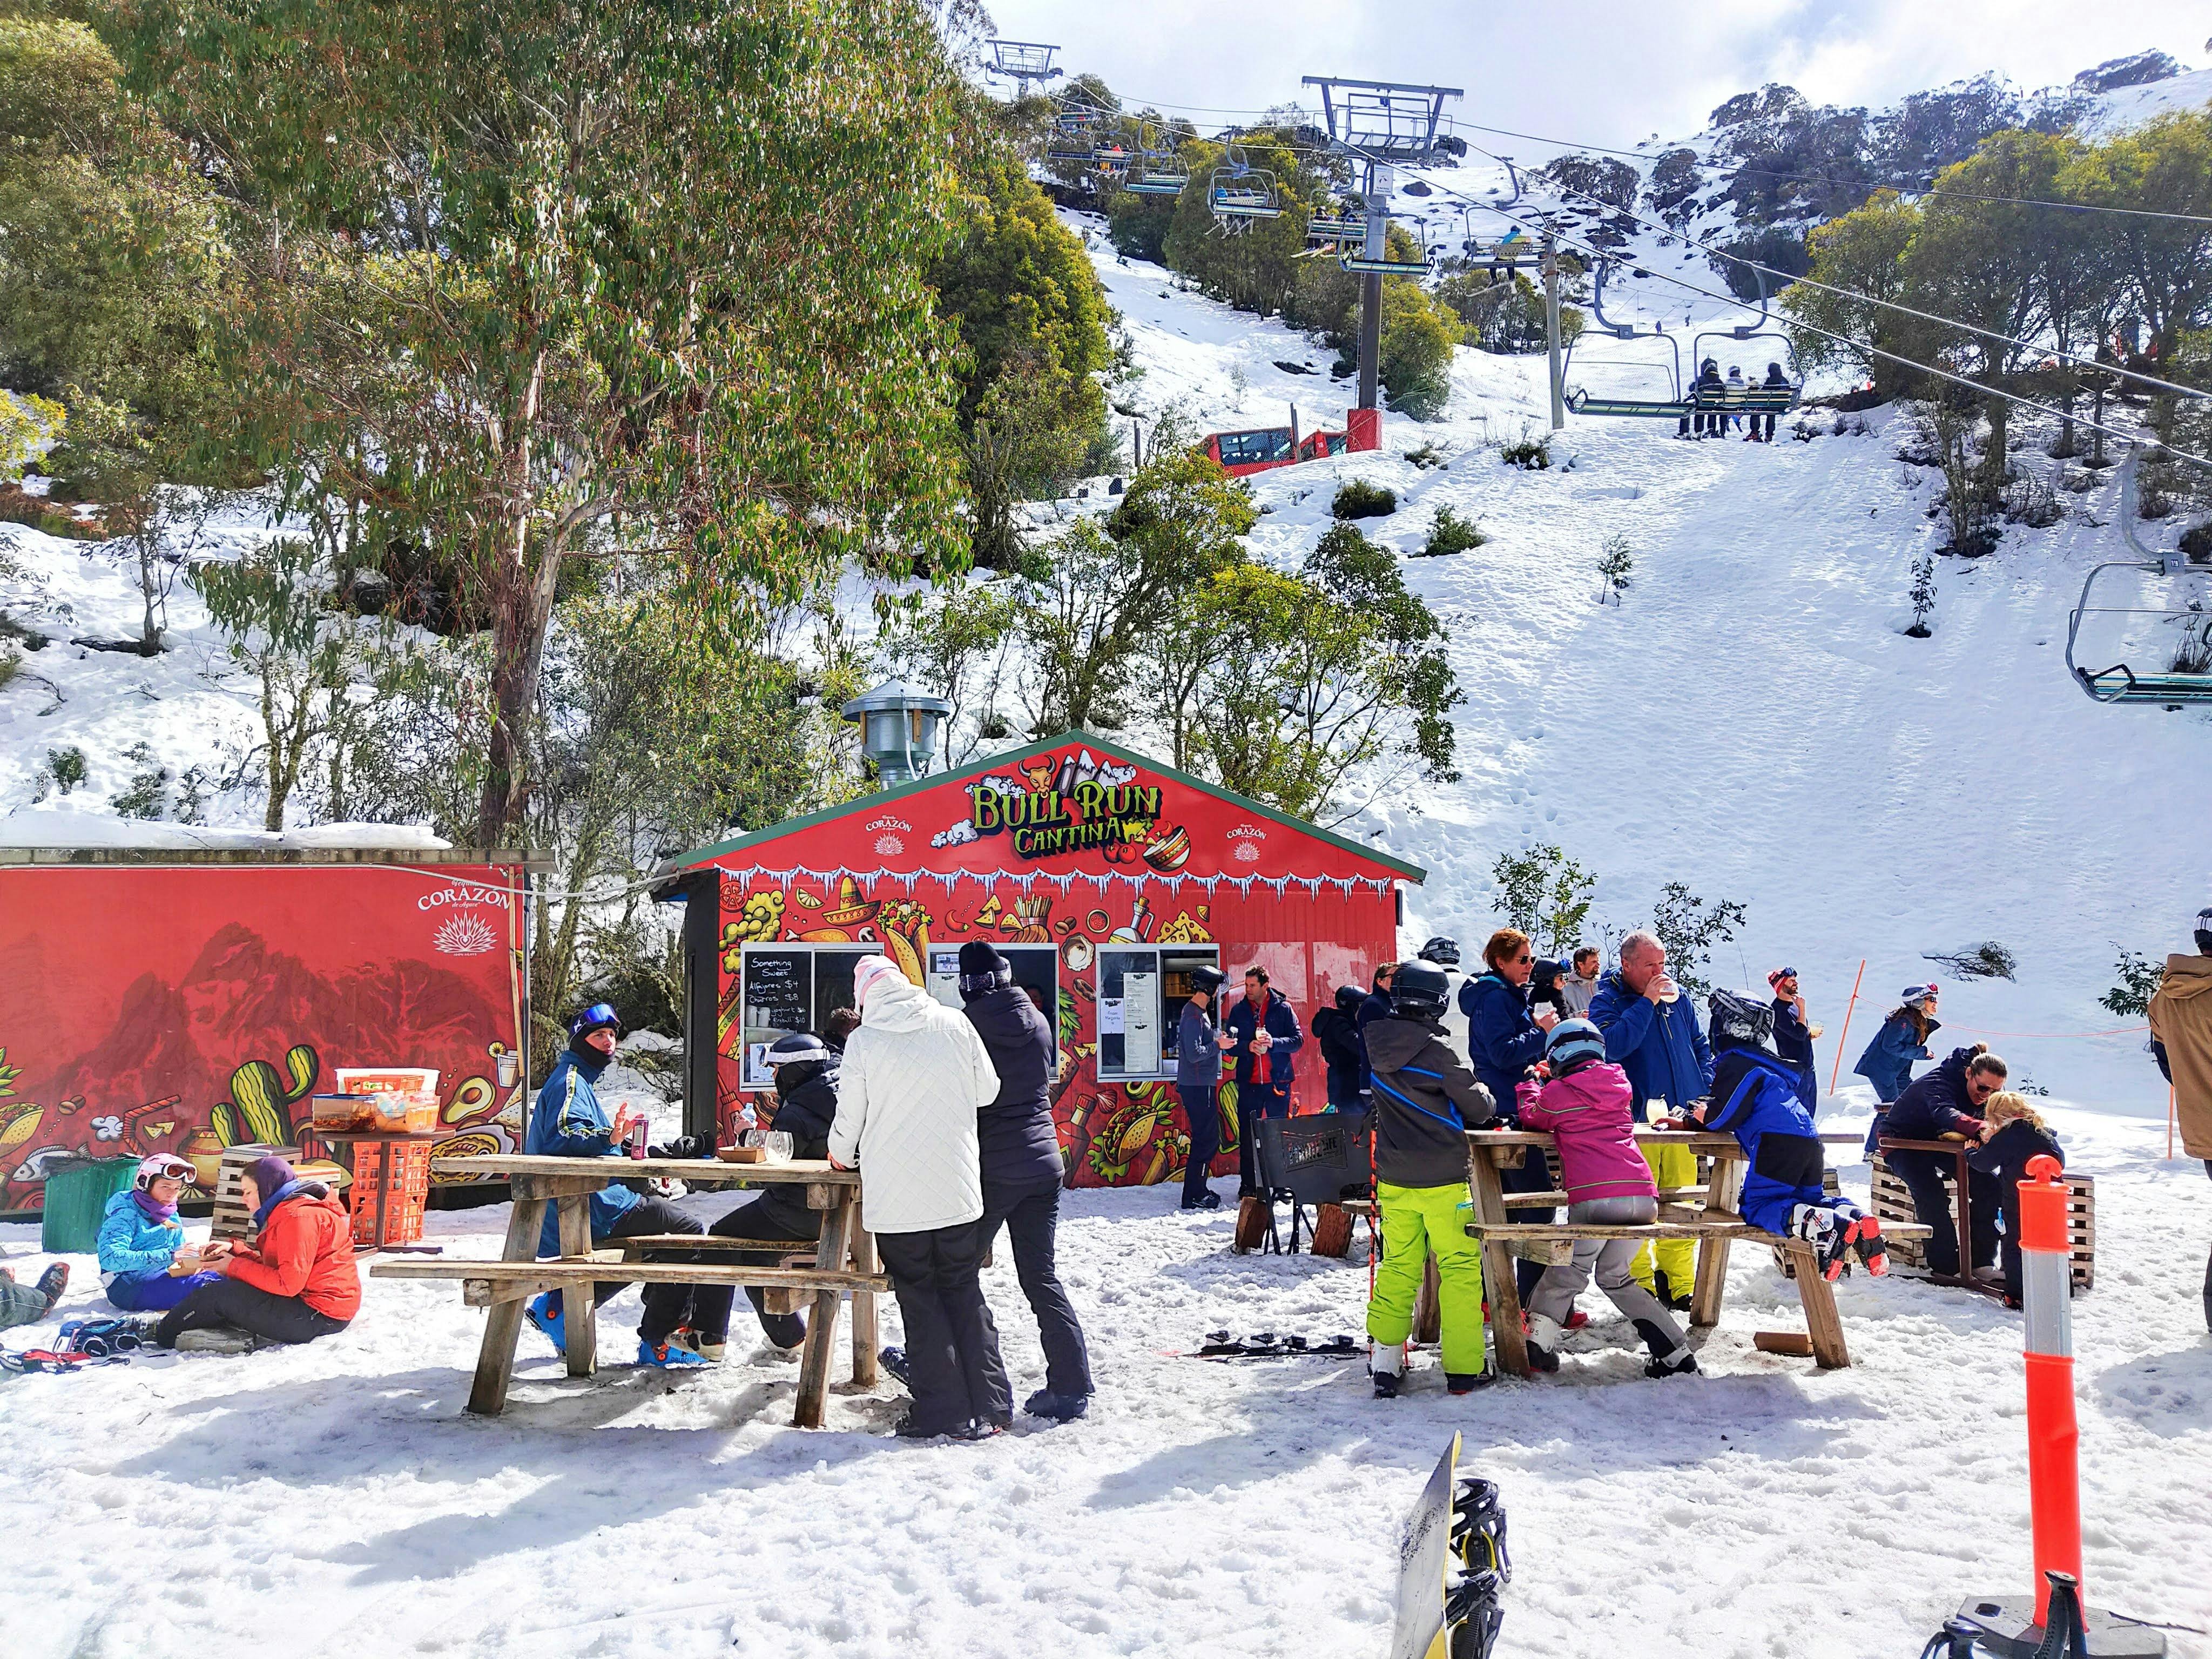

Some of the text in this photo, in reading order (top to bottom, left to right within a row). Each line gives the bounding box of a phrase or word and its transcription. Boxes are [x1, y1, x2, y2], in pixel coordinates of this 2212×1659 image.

[973, 780, 1158, 829] BULL RUN
[866, 819, 913, 832] CORAZÓN
[1014, 817, 1121, 853] CANTINA
[1226, 828, 1267, 840] CORAZÓN
[751, 957, 792, 970] Something
[749, 980, 798, 994] Alfajores $4
[771, 1006, 795, 1016] yoghurt
